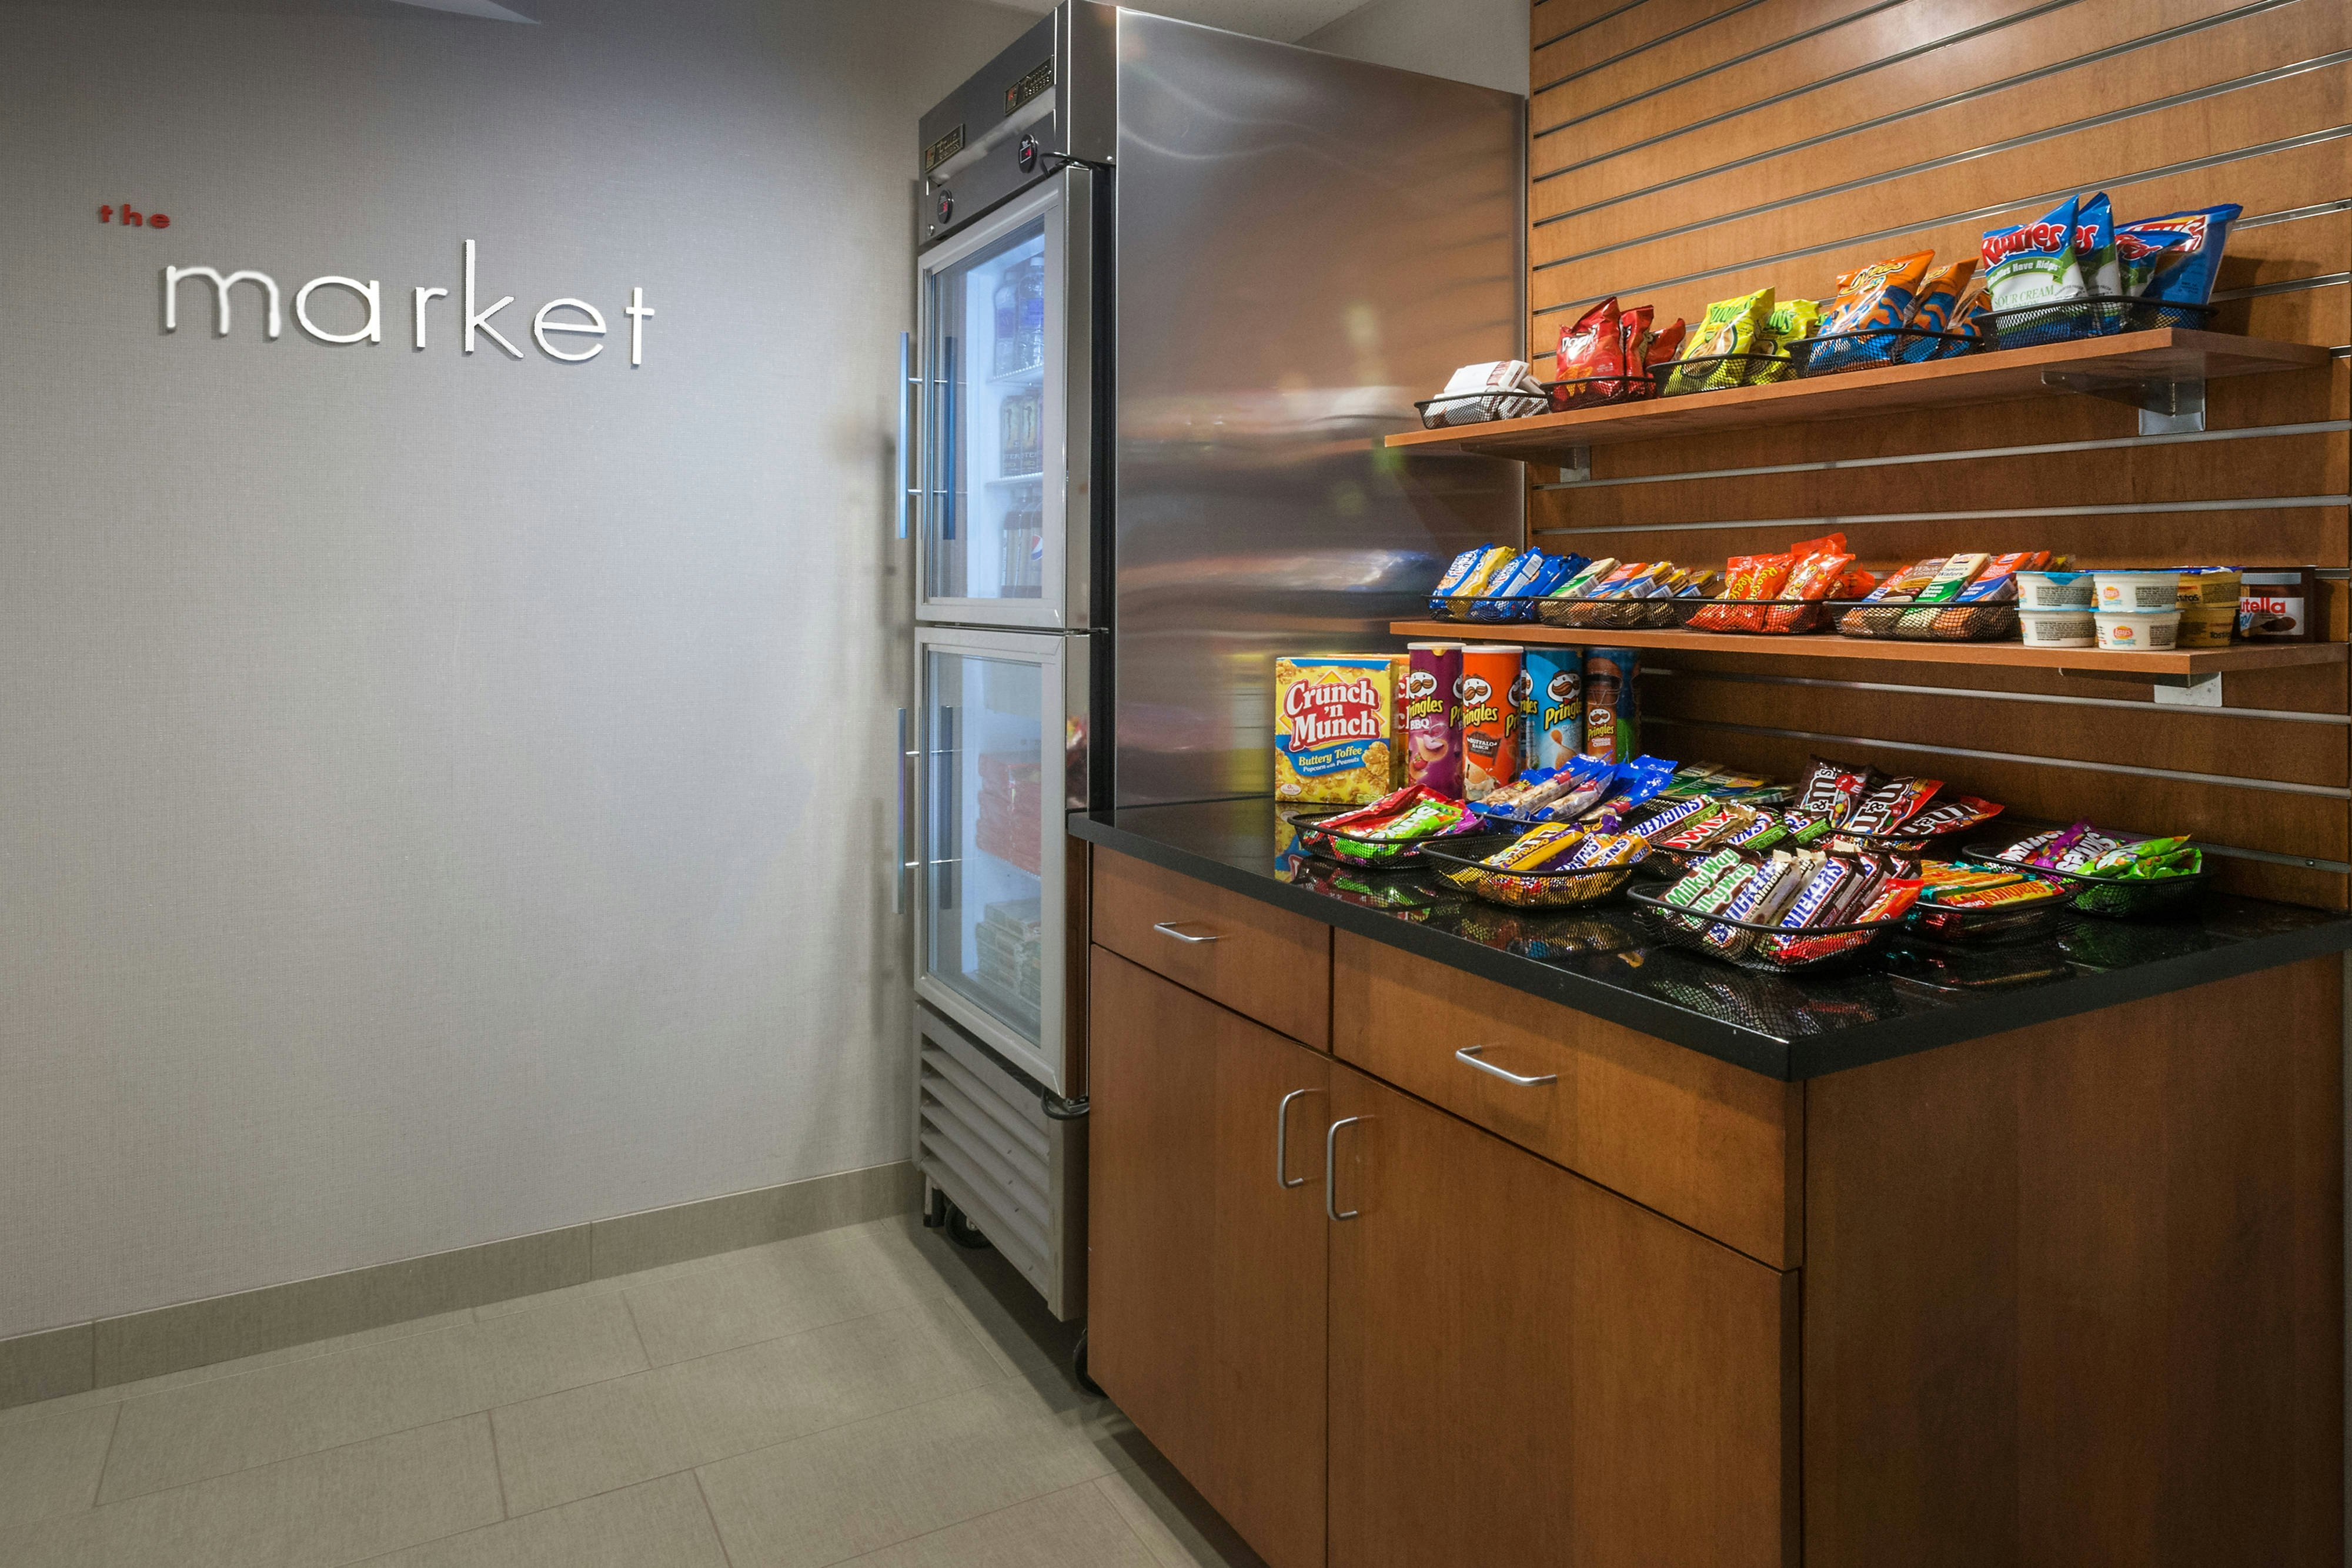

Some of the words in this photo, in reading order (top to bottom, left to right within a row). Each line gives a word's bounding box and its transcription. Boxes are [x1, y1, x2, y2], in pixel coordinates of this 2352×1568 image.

[99, 203, 171, 229] the
[2012, 262, 2034, 272] Have
[165, 239, 655, 365] market
[1994, 294, 2017, 307] SOUR
[2020, 285, 2054, 300] CREAM
[2240, 597, 2286, 614] utella
[1285, 680, 1377, 716] Crunch
[1409, 696, 1444, 719] ringles
[1410, 718, 1430, 730] BBQ
[1462, 703, 1498, 728] ringles
[1545, 697, 1582, 731] Pringle
[1293, 710, 1377, 747] Munch
[1299, 753, 1332, 766] Buttery
[1334, 746, 1363, 758] Toffee
[1303, 764, 1327, 773] Popcorn
[1337, 757, 1359, 766] Peanuts
[1665, 871, 1715, 906] Milky
[1700, 848, 1740, 878] Way
[1692, 886, 1731, 912] ilky
[1721, 862, 1757, 889] Way
[1780, 859, 1845, 928] NICKERS
